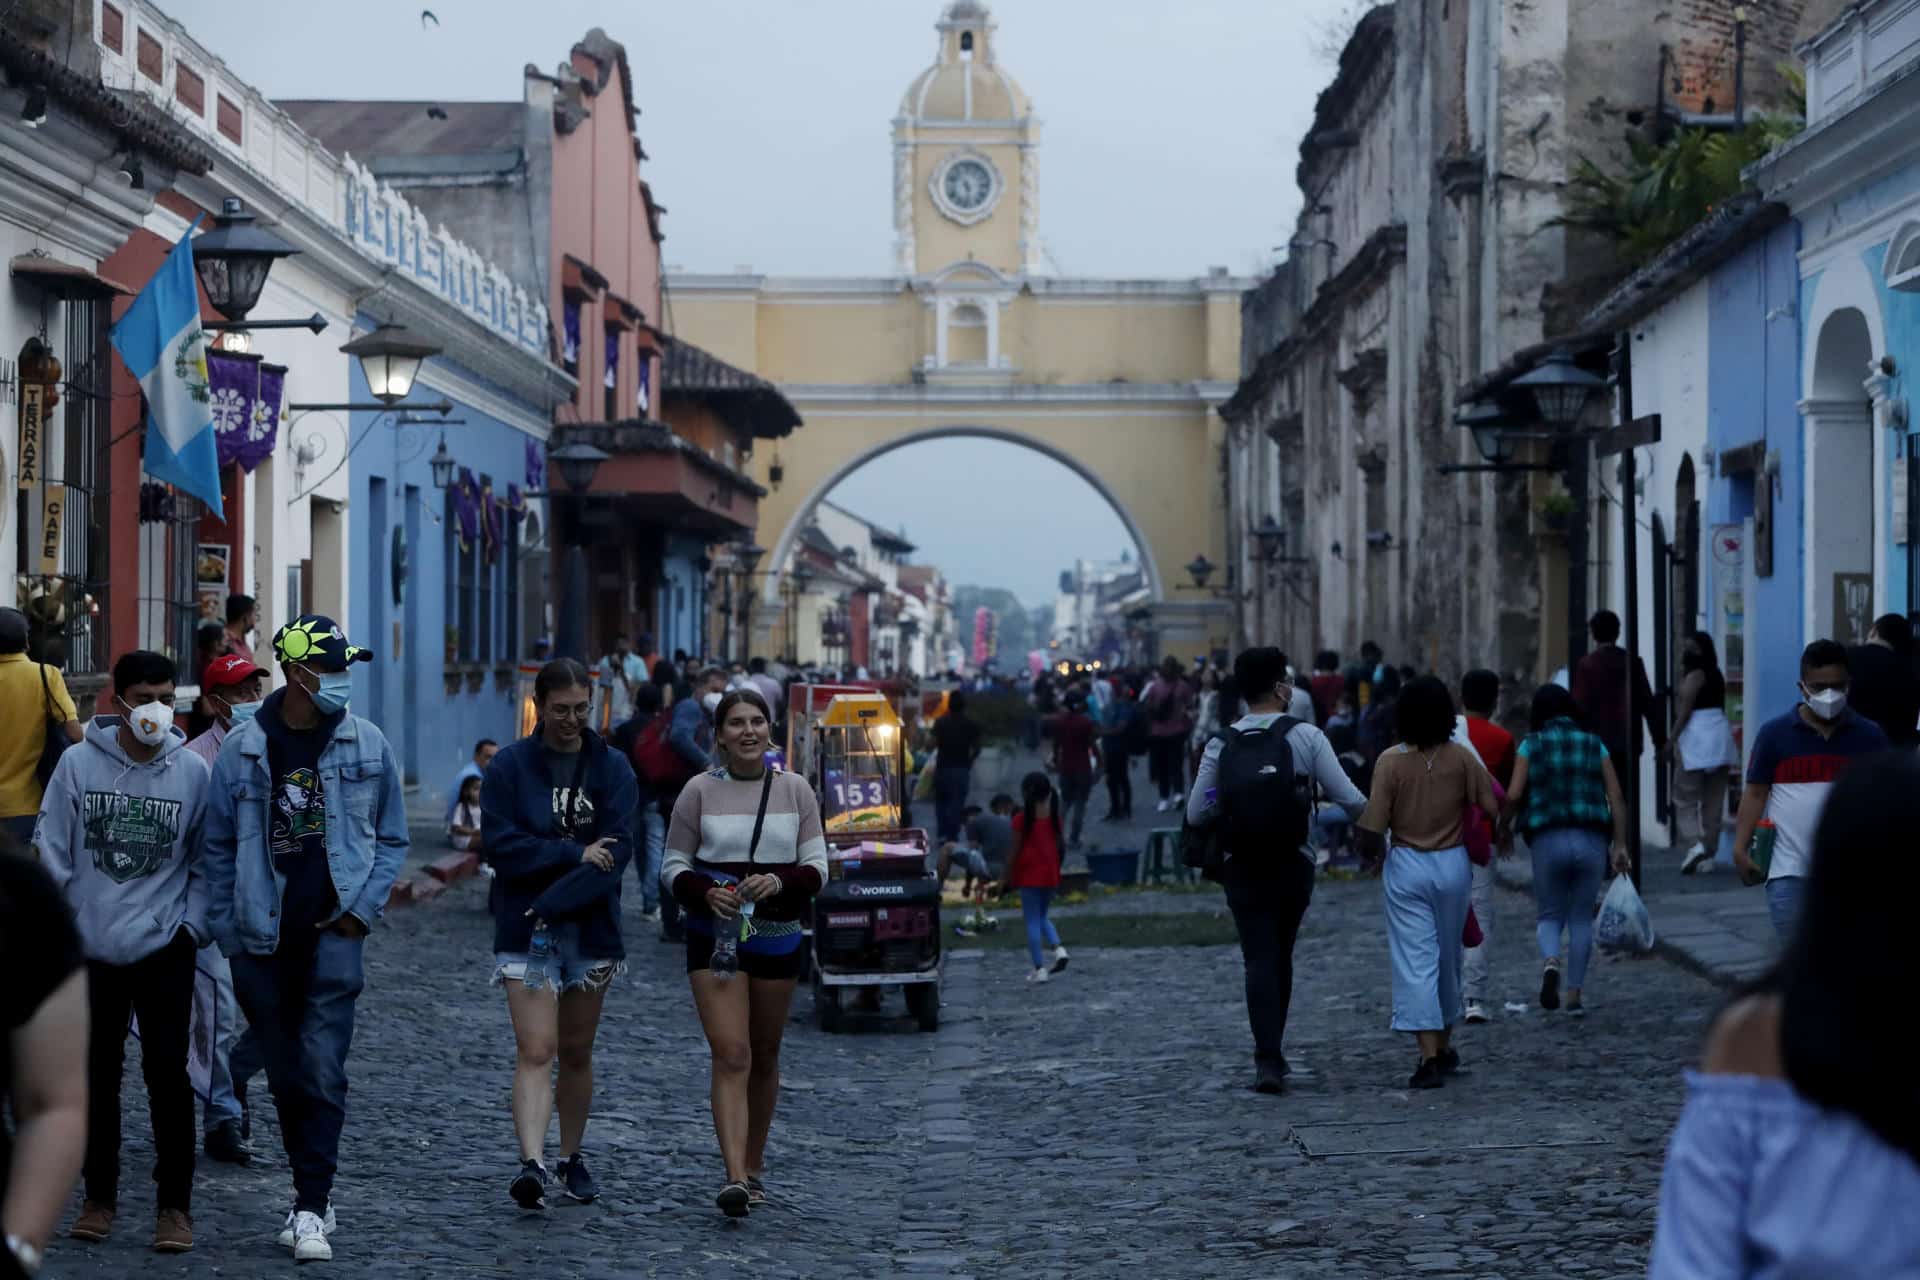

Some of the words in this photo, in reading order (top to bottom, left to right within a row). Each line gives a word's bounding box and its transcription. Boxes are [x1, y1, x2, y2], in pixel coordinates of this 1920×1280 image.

[22, 389, 37, 482] TERRAZA
[44, 503, 59, 558] CAFE
[85, 793, 128, 823] SILVER
[145, 799, 180, 825] STICK
[860, 886, 905, 895] WORKER
